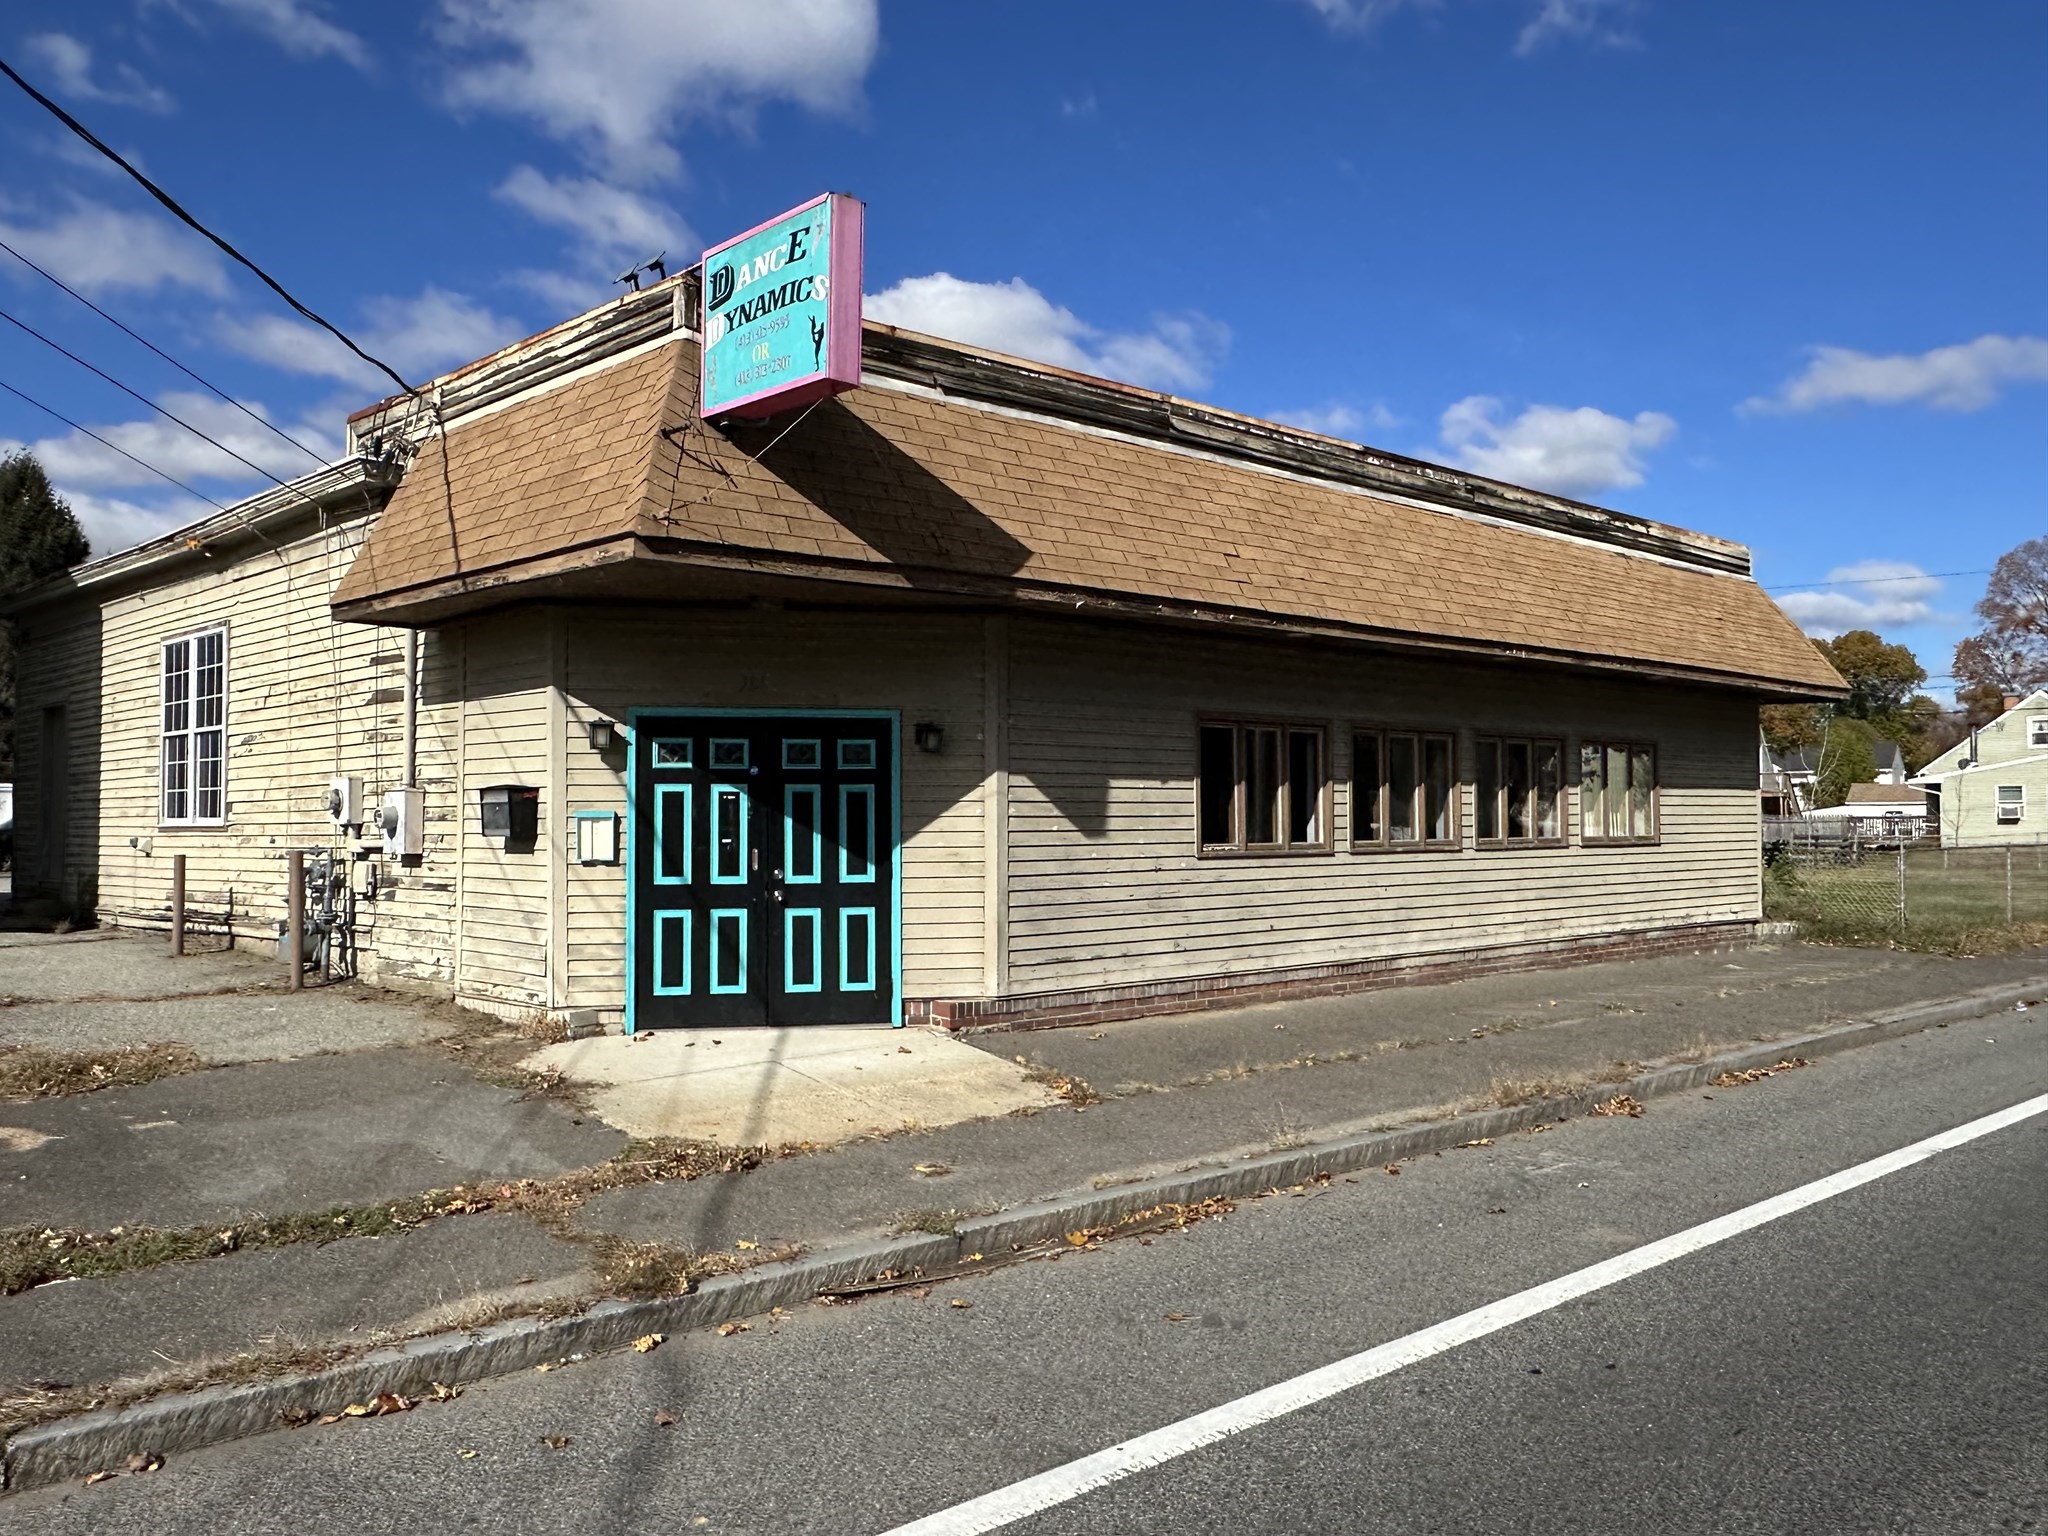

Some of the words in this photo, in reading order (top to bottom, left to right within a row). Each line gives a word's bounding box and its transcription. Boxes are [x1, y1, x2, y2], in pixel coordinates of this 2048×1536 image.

[708, 226, 811, 311] DANCE
[705, 274, 830, 352] DYNAMICS
[752, 342, 769, 363] OR
